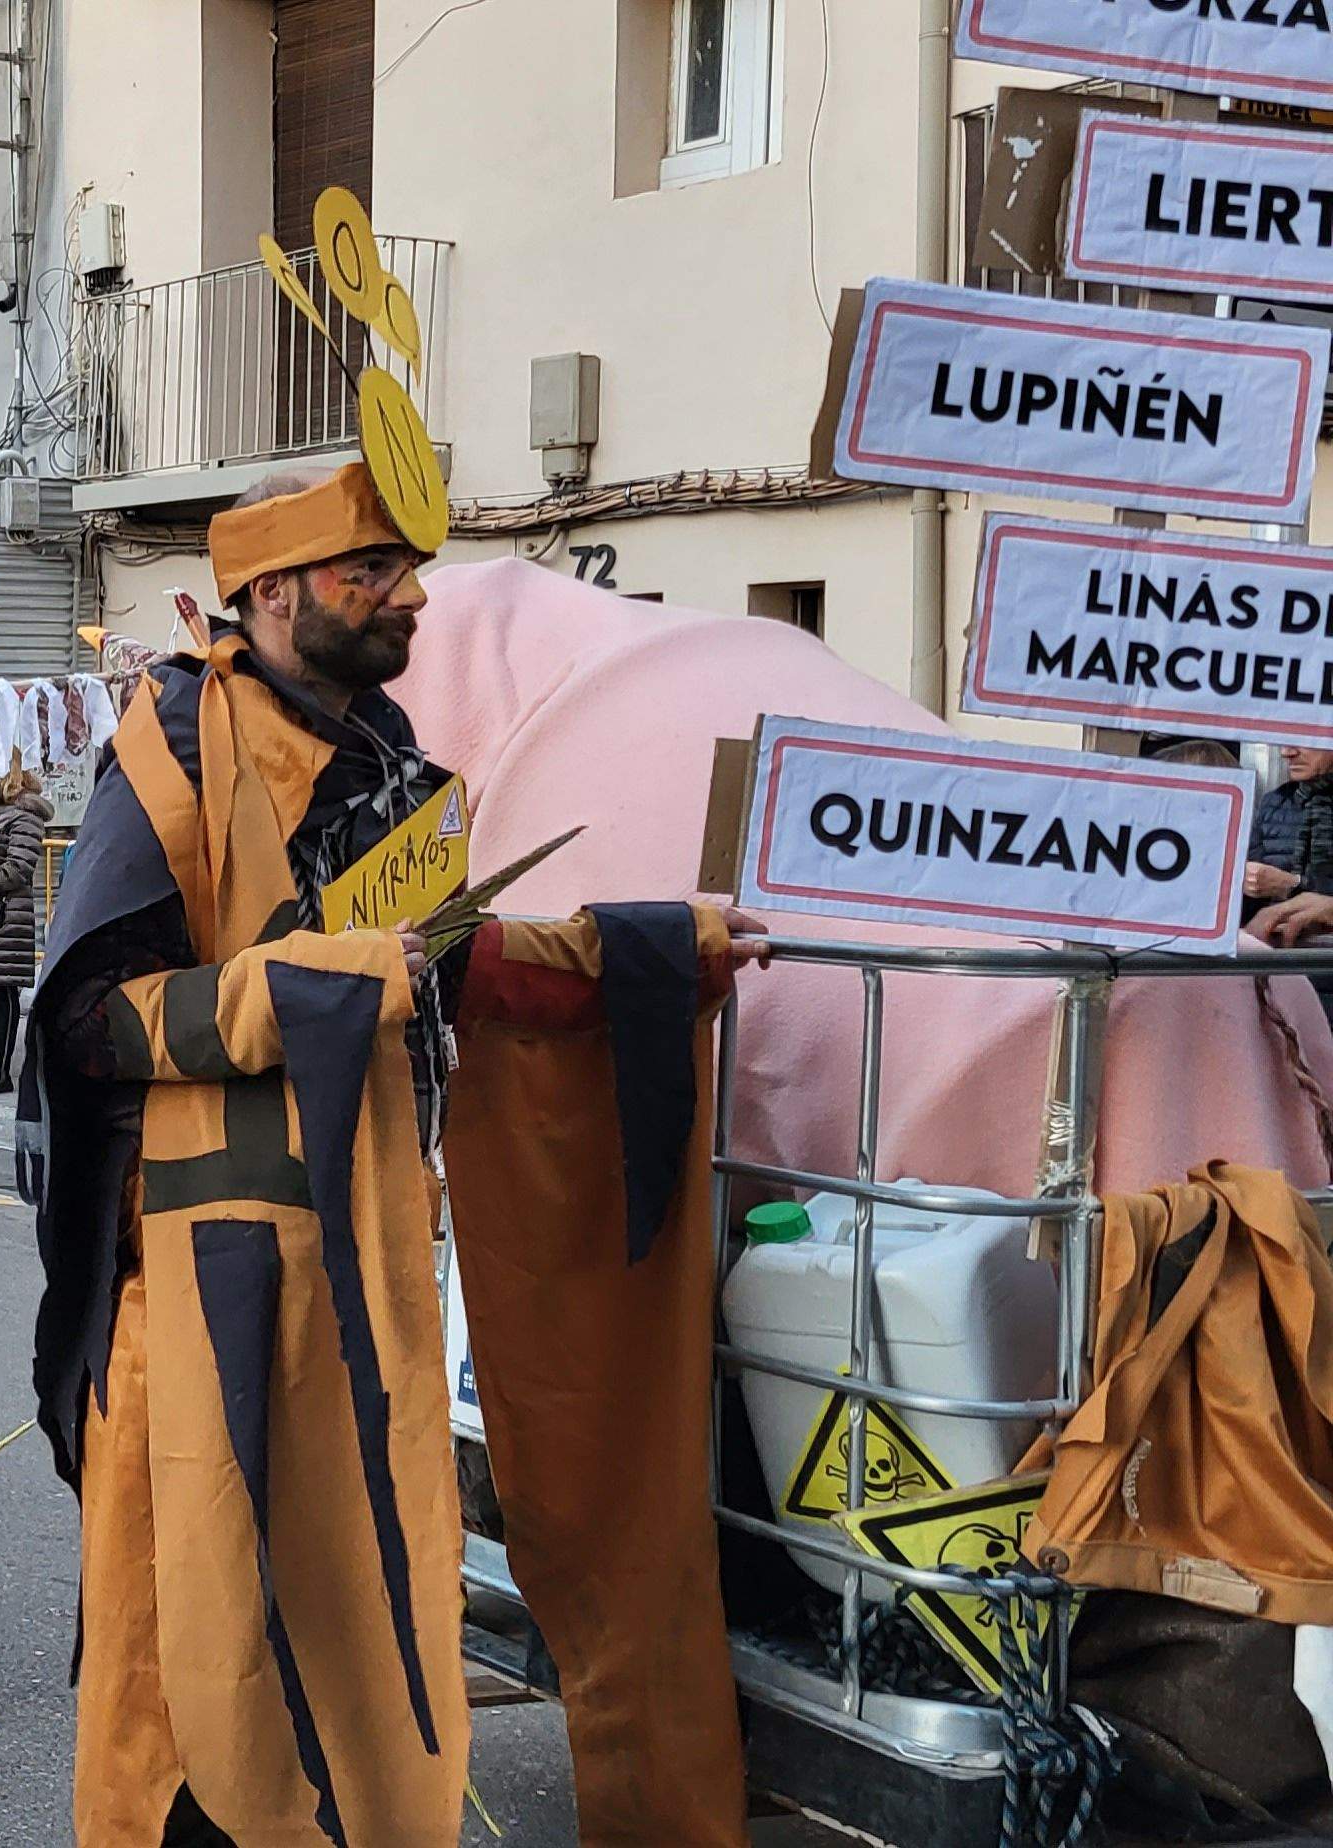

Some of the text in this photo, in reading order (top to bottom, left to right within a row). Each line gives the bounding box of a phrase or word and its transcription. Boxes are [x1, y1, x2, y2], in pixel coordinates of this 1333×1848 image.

[930, 363, 1223, 448] LUPIÑÉN
[569, 544, 617, 589] 72
[1085, 568, 1260, 630] LINÁS
[810, 792, 1191, 882] QUINZANO
[351, 832, 450, 929] NITRATOS
